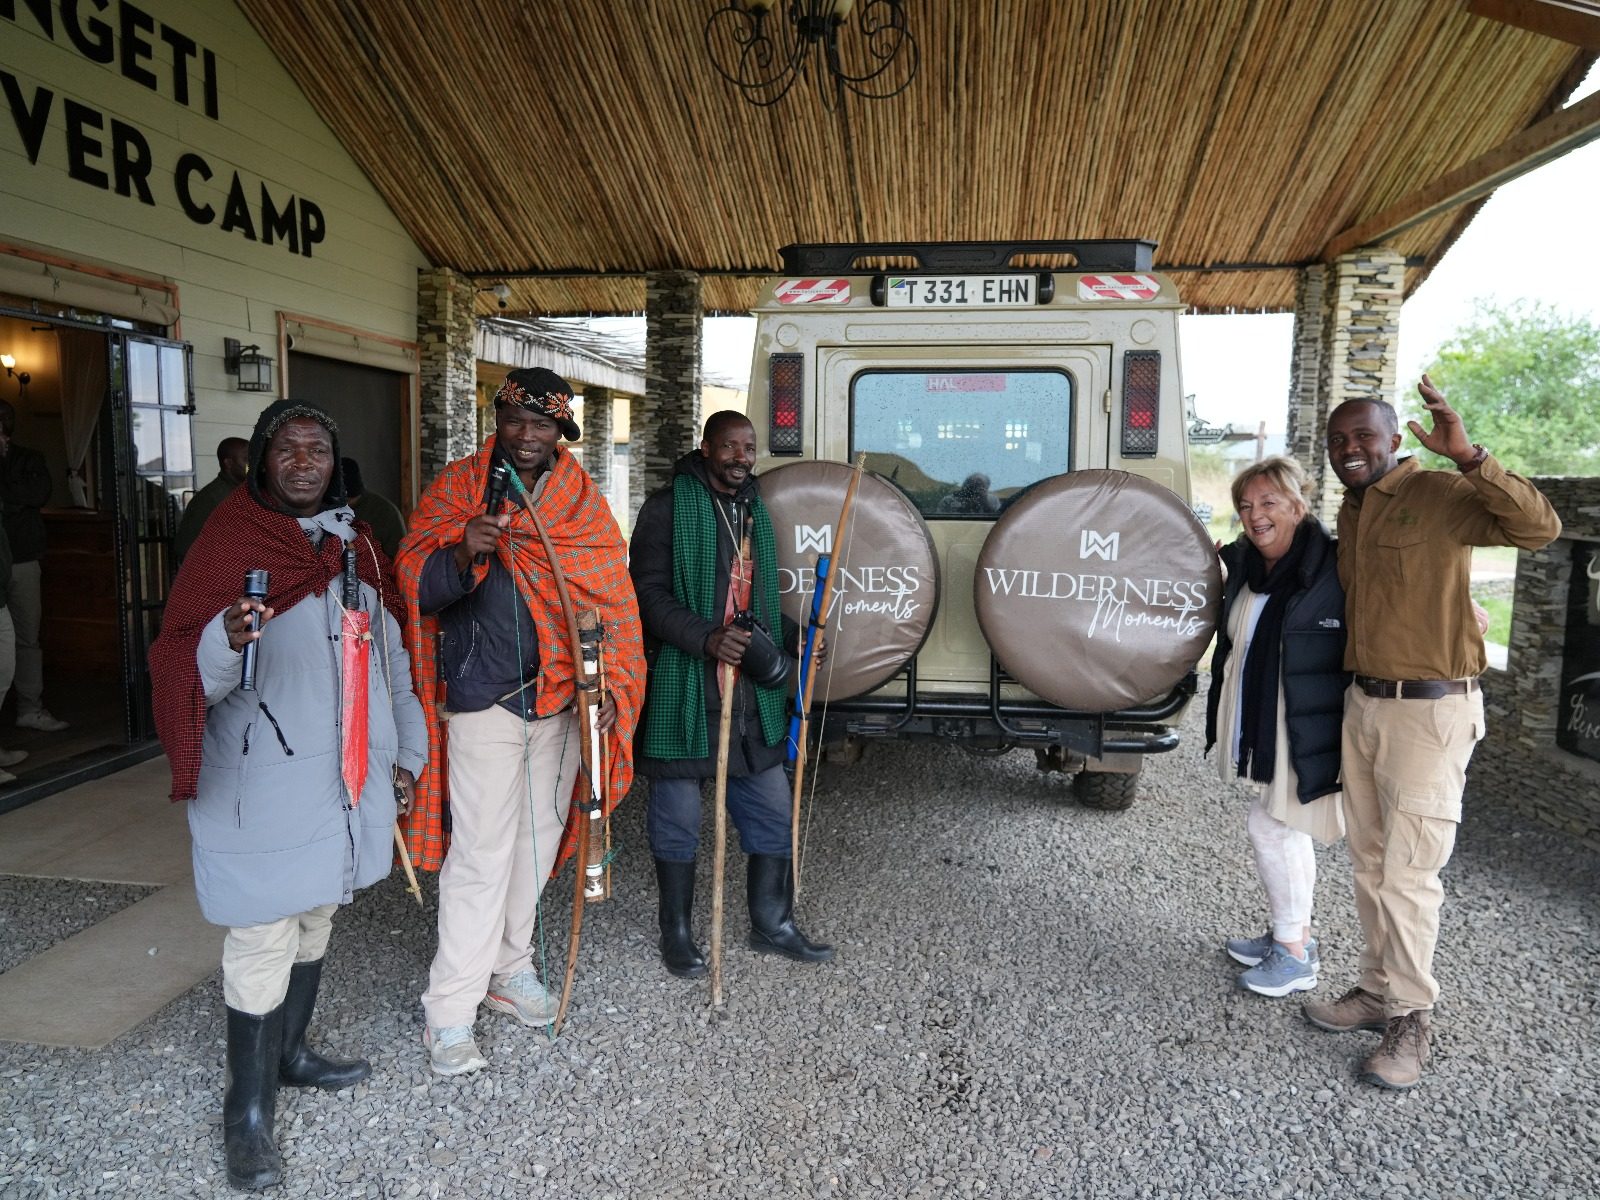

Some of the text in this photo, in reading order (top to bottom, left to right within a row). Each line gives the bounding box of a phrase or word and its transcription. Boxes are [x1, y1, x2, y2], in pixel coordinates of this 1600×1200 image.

[0, 69, 326, 258] VER CAMP
[905, 278, 1029, 304] T 331 EHN
[778, 566, 920, 594] DENESS
[984, 567, 1208, 609] WILDERNESS
[1088, 593, 1205, 642] Moments
